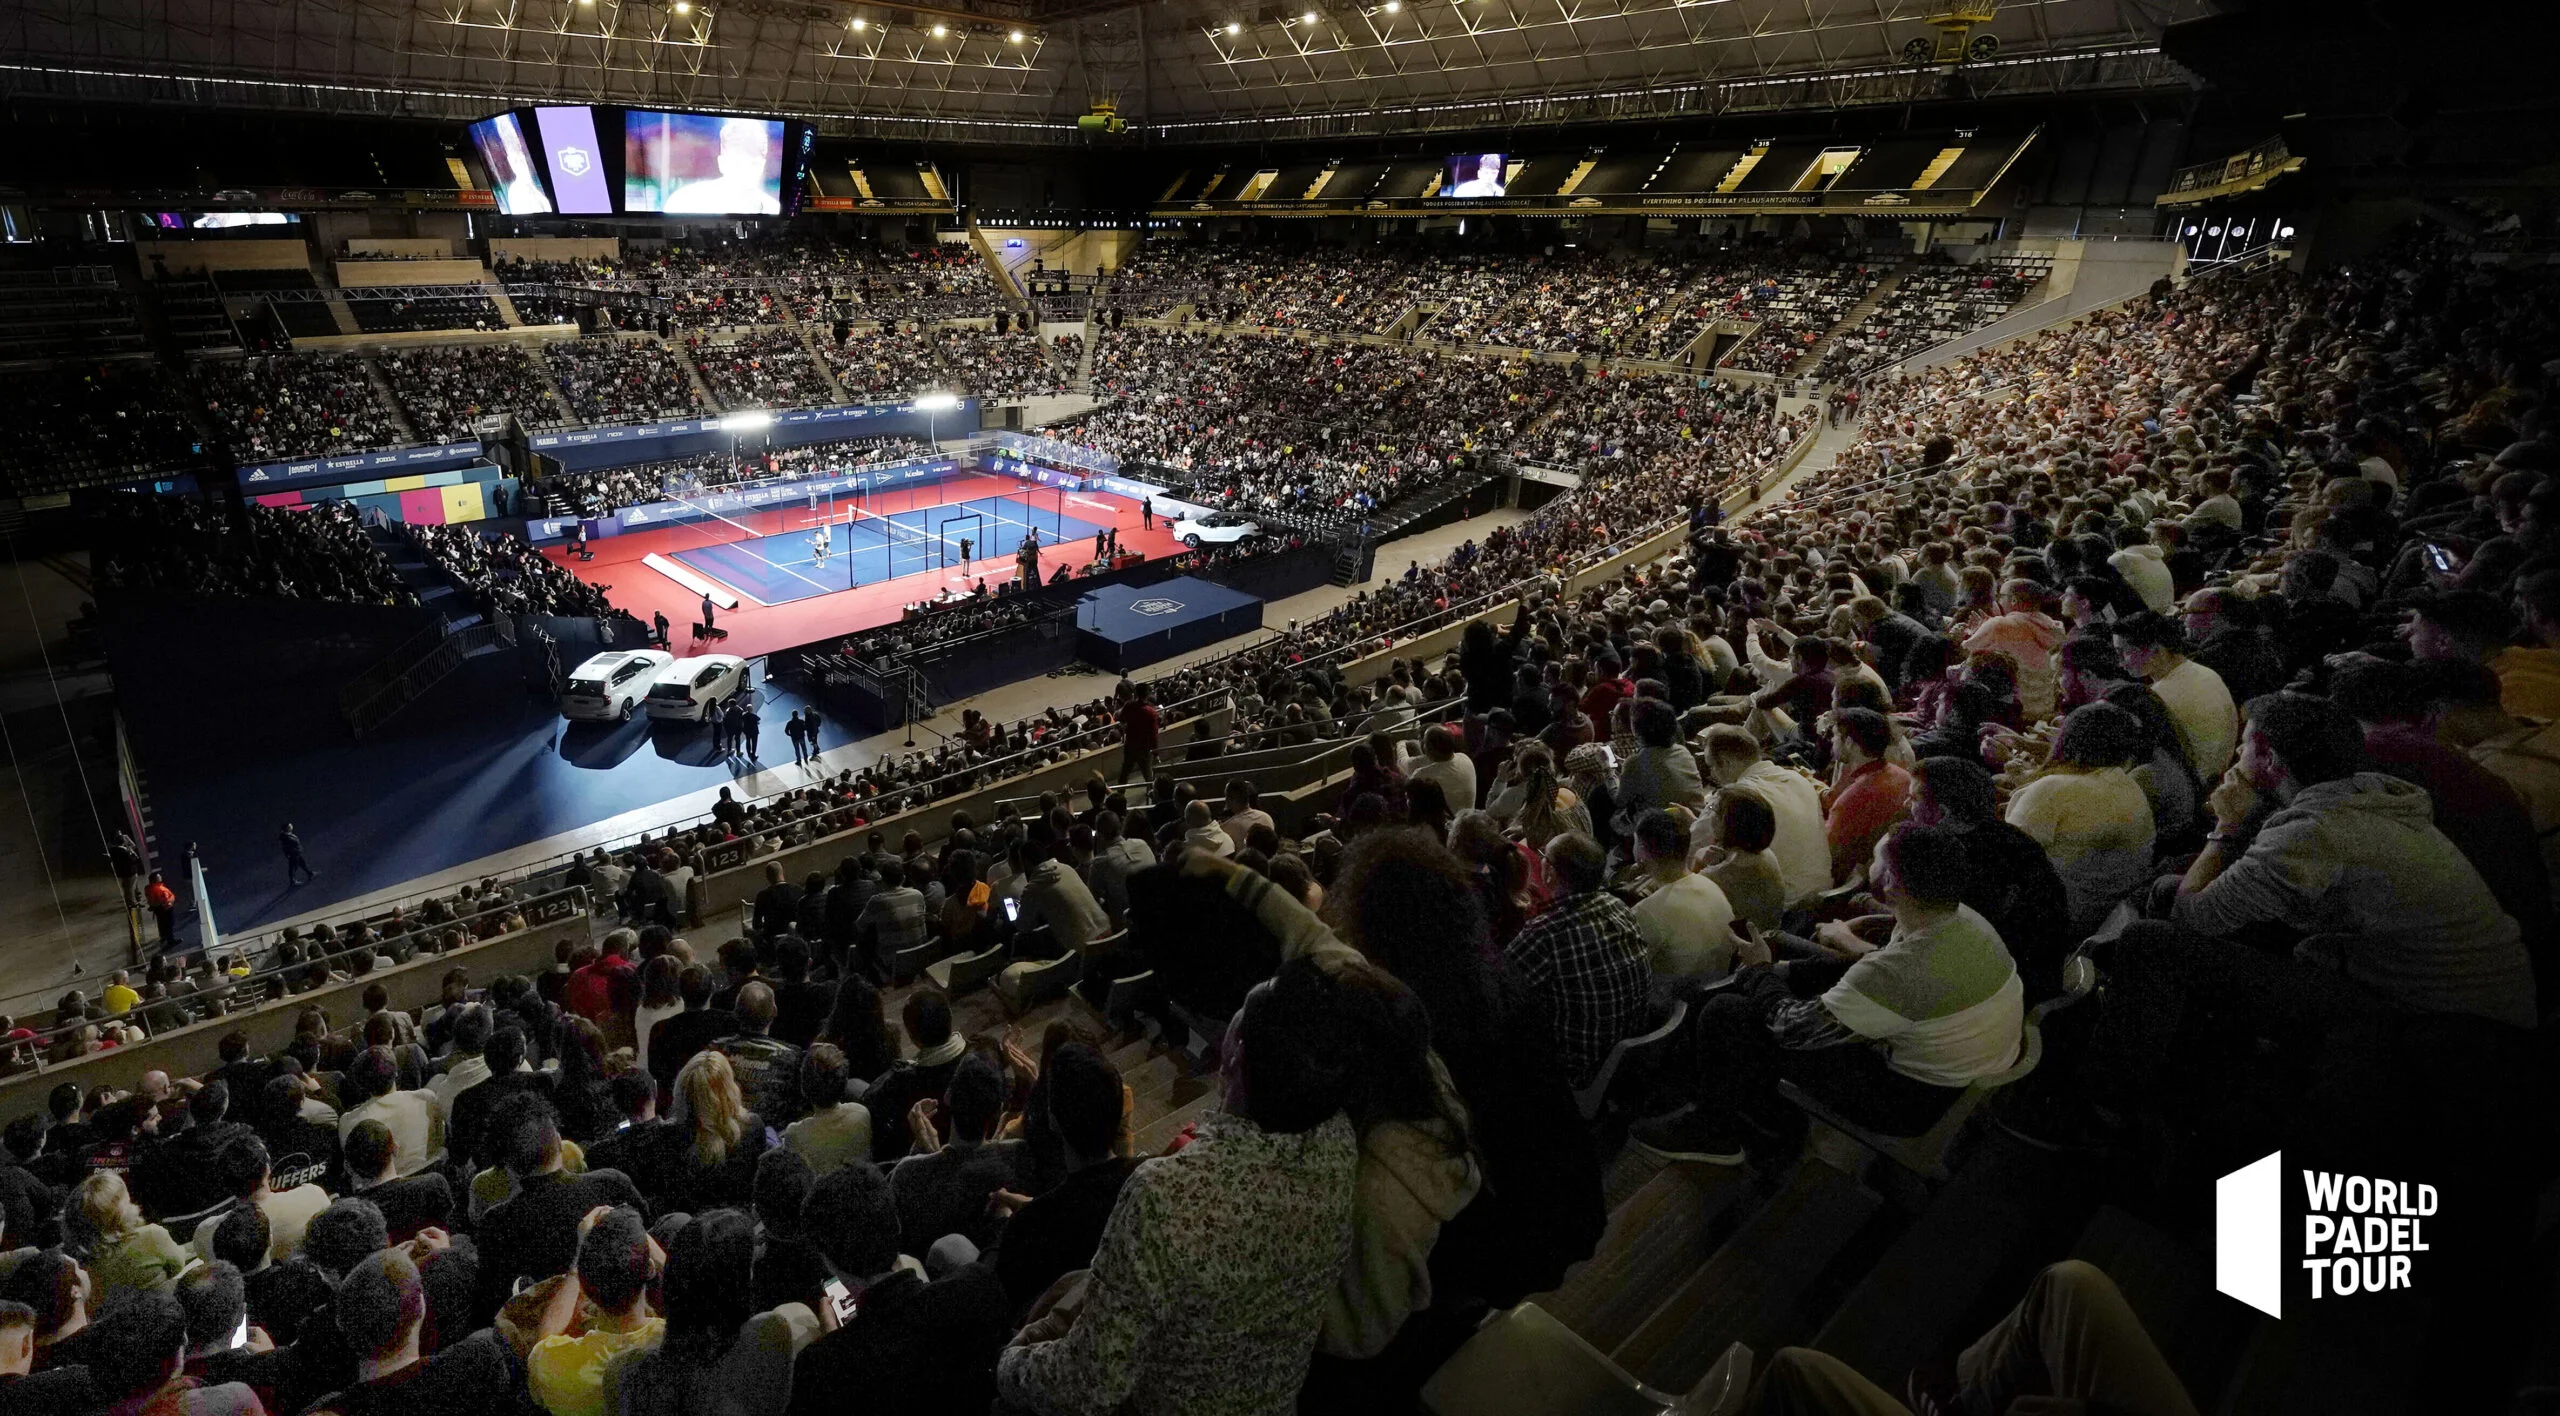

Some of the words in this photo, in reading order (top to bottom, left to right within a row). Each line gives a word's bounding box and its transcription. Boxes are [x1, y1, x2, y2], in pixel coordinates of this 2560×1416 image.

[336, 459, 364, 467] ESTRELLA
[712, 850, 738, 867] 123
[538, 899, 570, 919] 123
[271, 1161, 328, 1190] UFFERS
